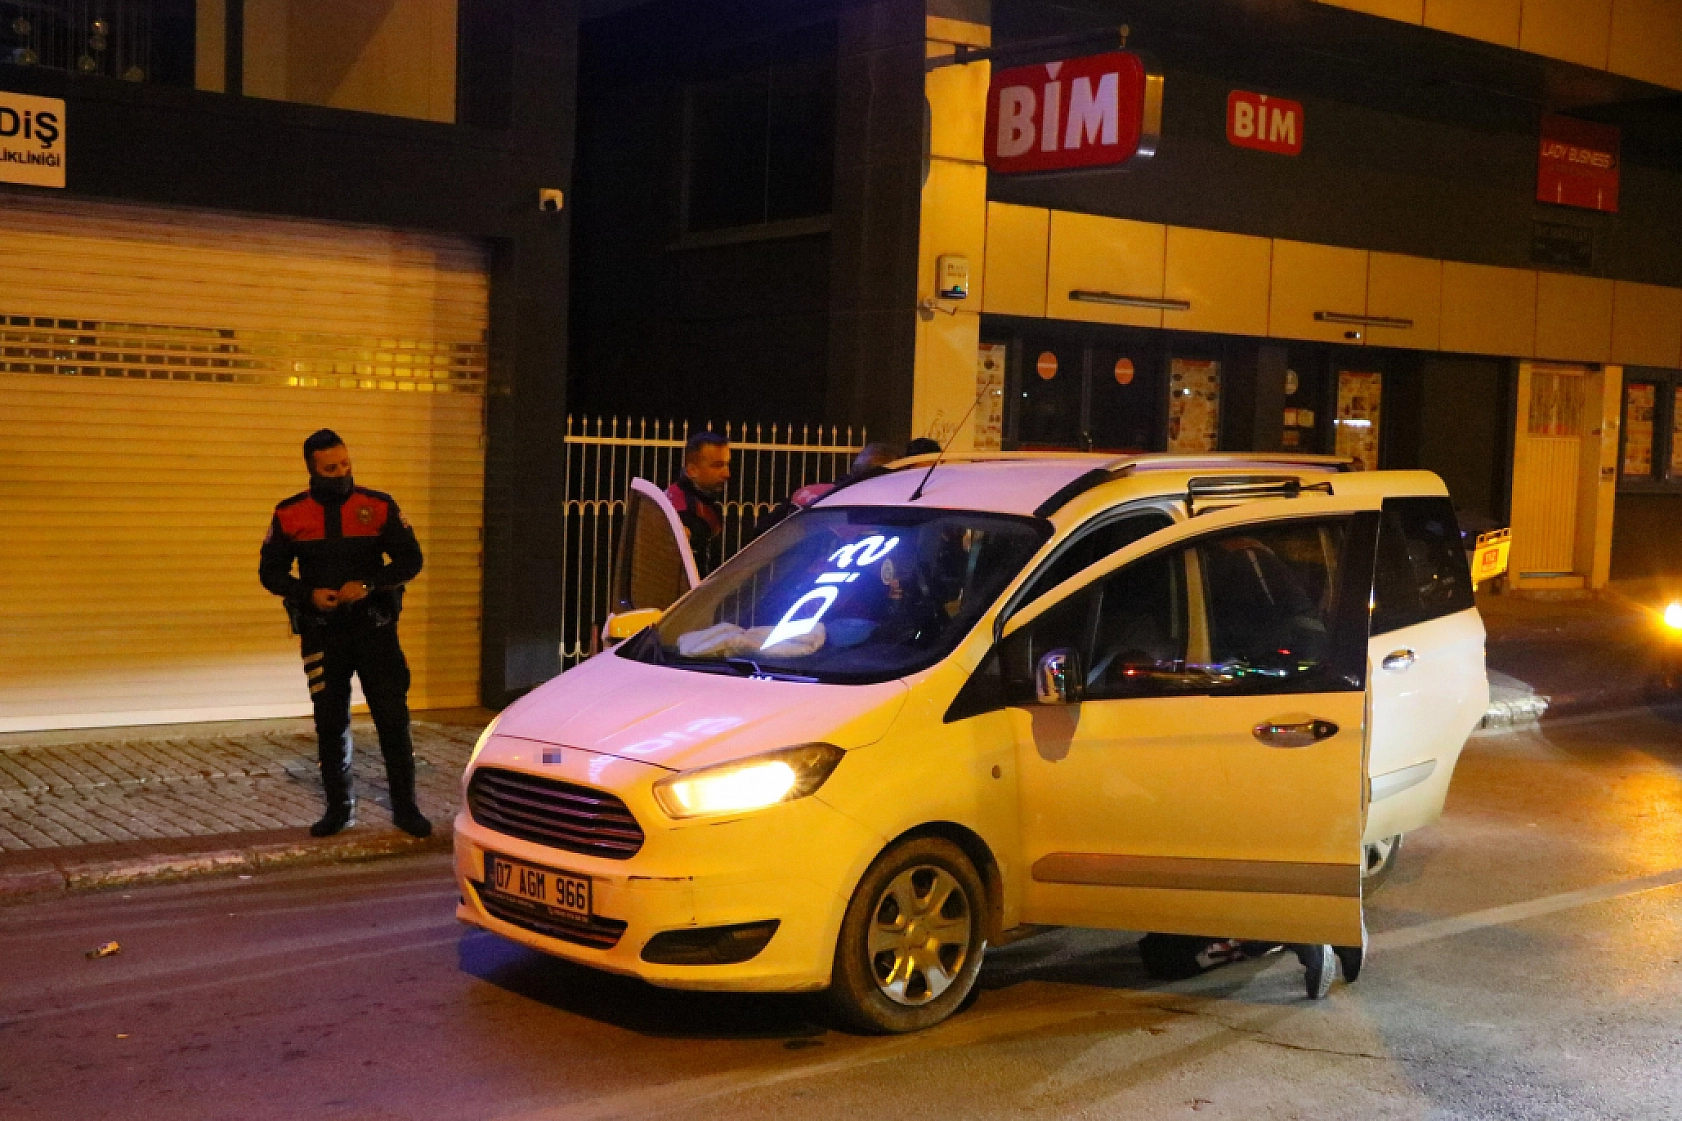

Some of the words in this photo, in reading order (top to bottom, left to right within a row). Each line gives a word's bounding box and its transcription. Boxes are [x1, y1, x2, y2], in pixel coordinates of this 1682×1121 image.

[996, 61, 1119, 157] BİM
[1234, 94, 1296, 145] BİM
[496, 862, 512, 889] 07
[519, 868, 546, 900] AGM
[556, 877, 586, 910] 966
